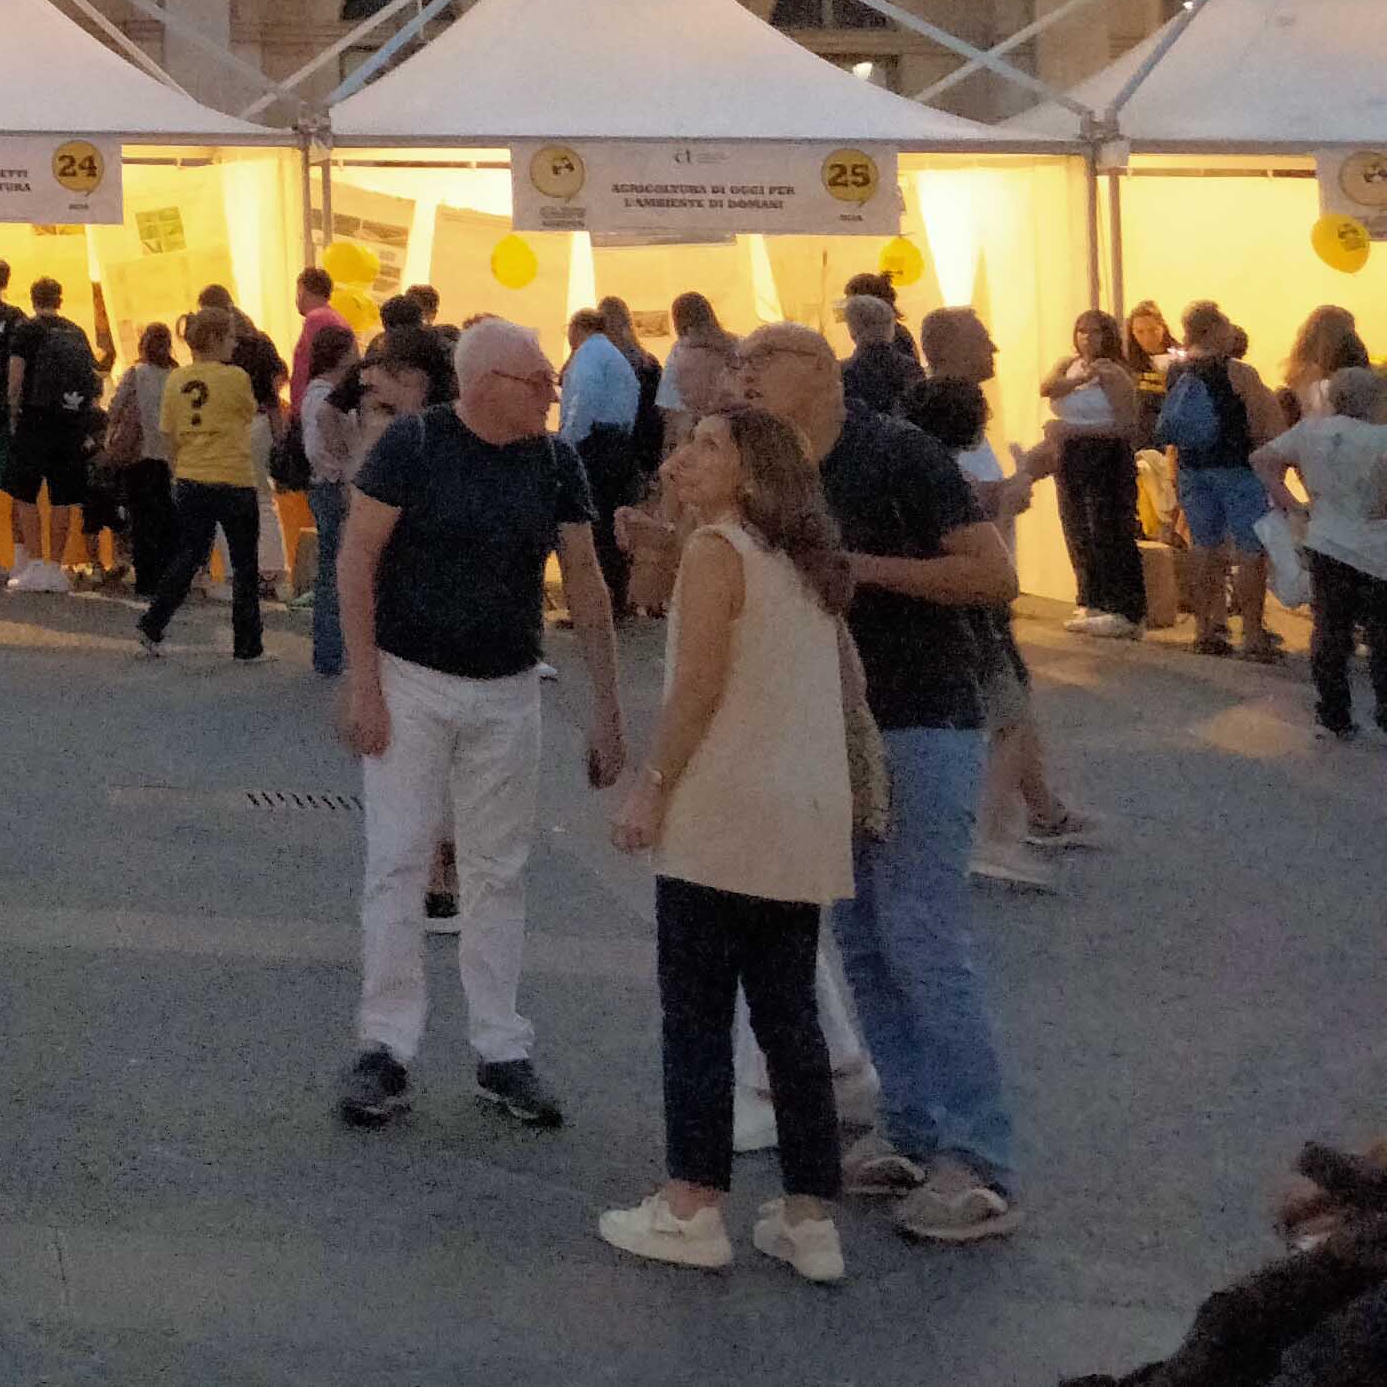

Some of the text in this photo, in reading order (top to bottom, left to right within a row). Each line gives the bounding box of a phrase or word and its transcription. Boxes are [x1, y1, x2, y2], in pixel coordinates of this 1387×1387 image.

[57, 154, 98, 178] 24
[827, 163, 870, 188] 25
[611, 183, 796, 196] AGRICOLTURA DI OGGI PER
[624, 197, 784, 210] L'AMBIENTE DI DOMANI
